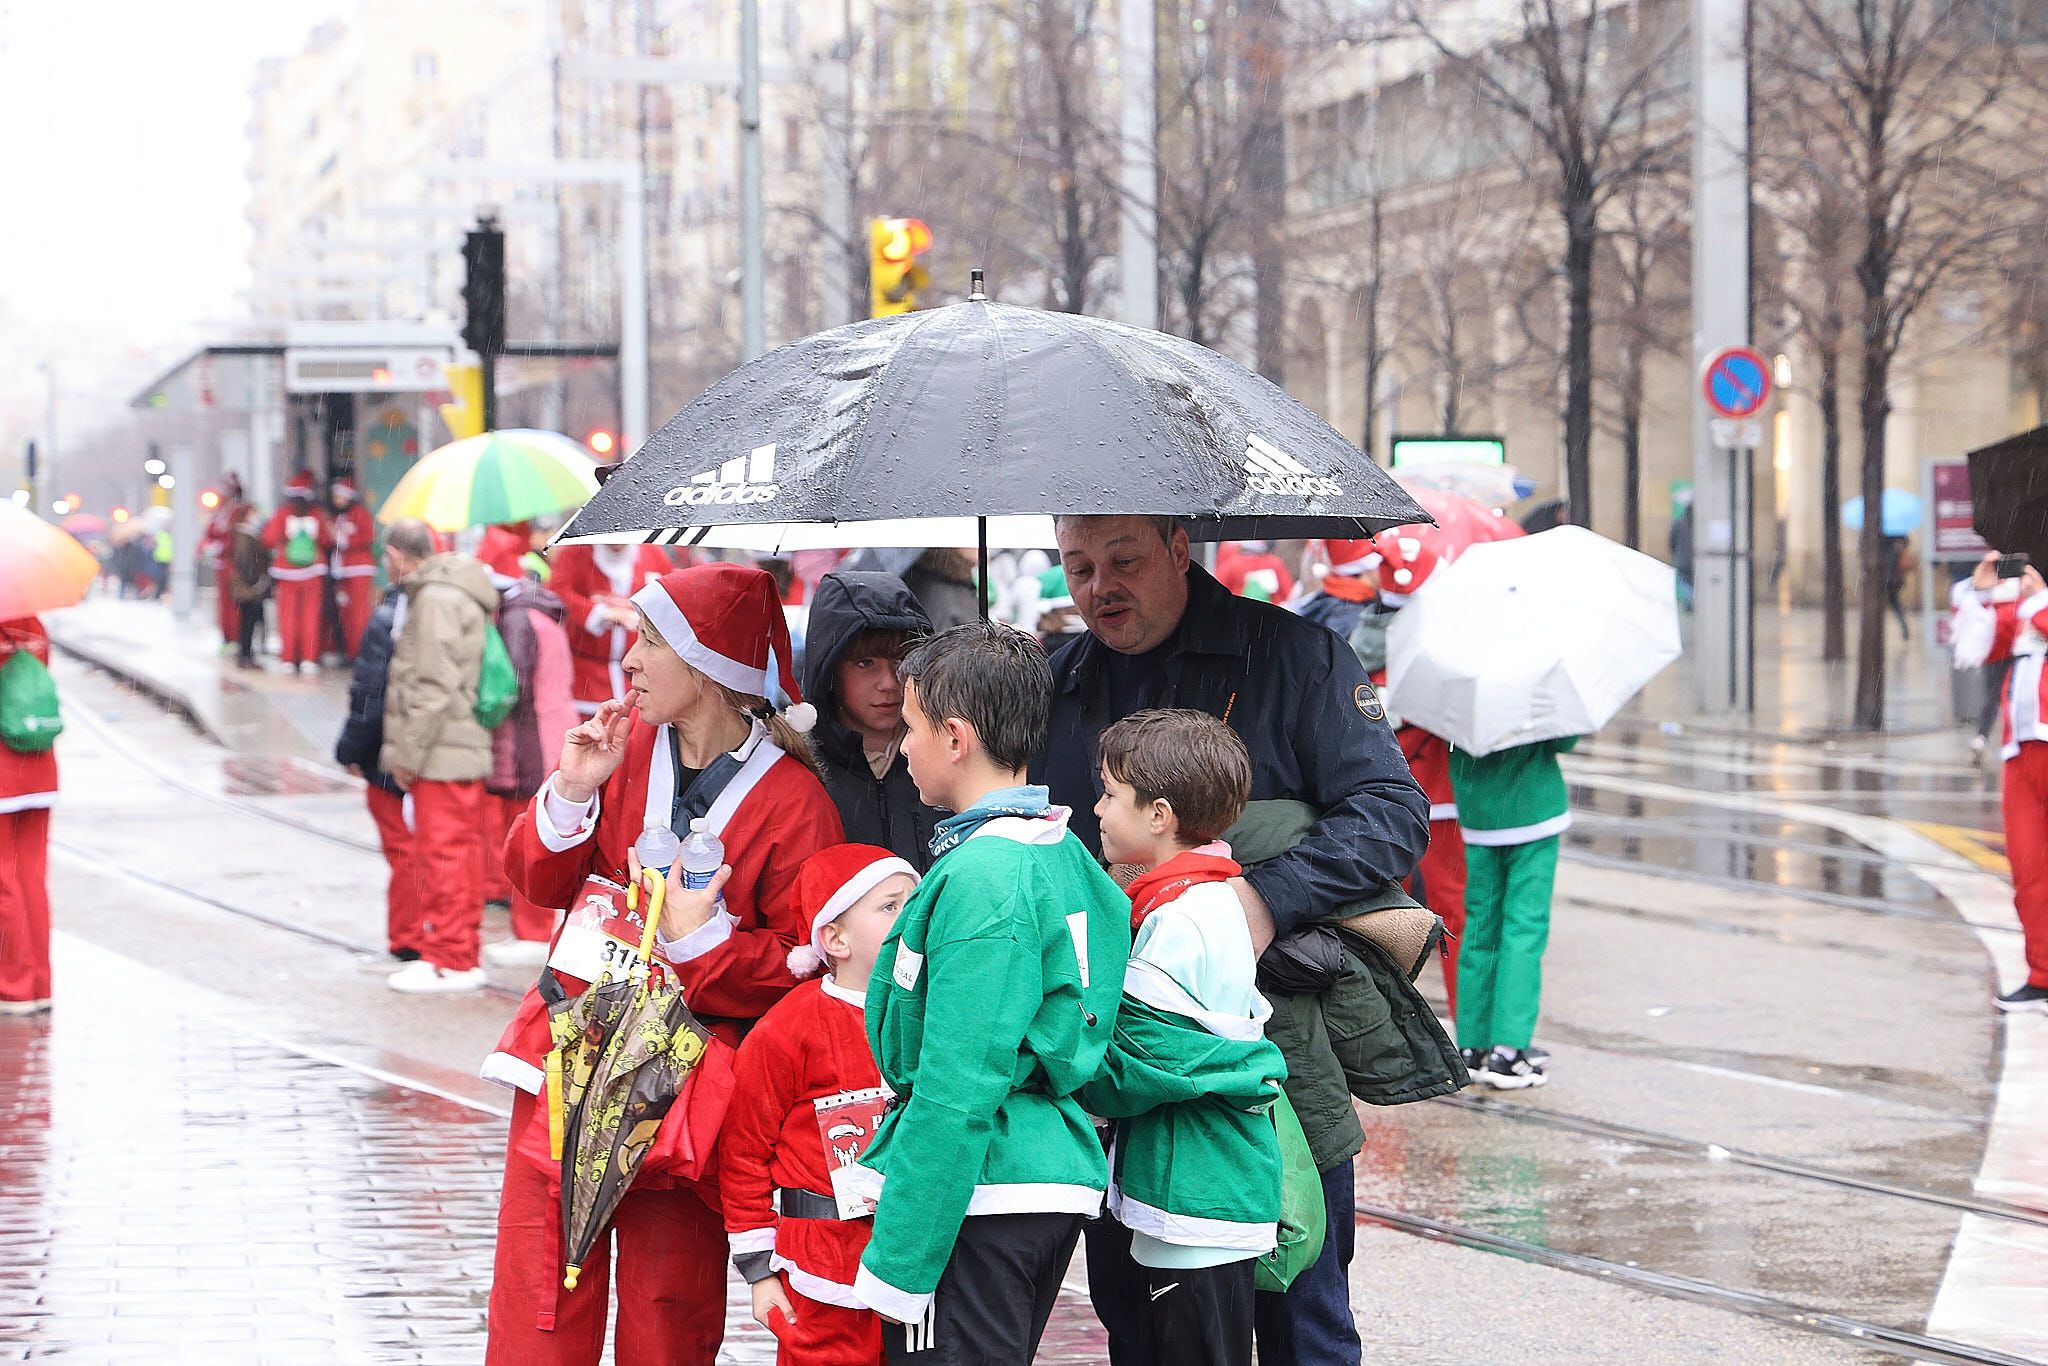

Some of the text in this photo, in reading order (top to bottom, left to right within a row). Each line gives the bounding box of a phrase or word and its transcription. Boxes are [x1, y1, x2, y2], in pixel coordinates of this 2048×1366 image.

[663, 480, 780, 505] adidas
[1246, 471, 1344, 496] adidas
[934, 833, 960, 857] DKV
